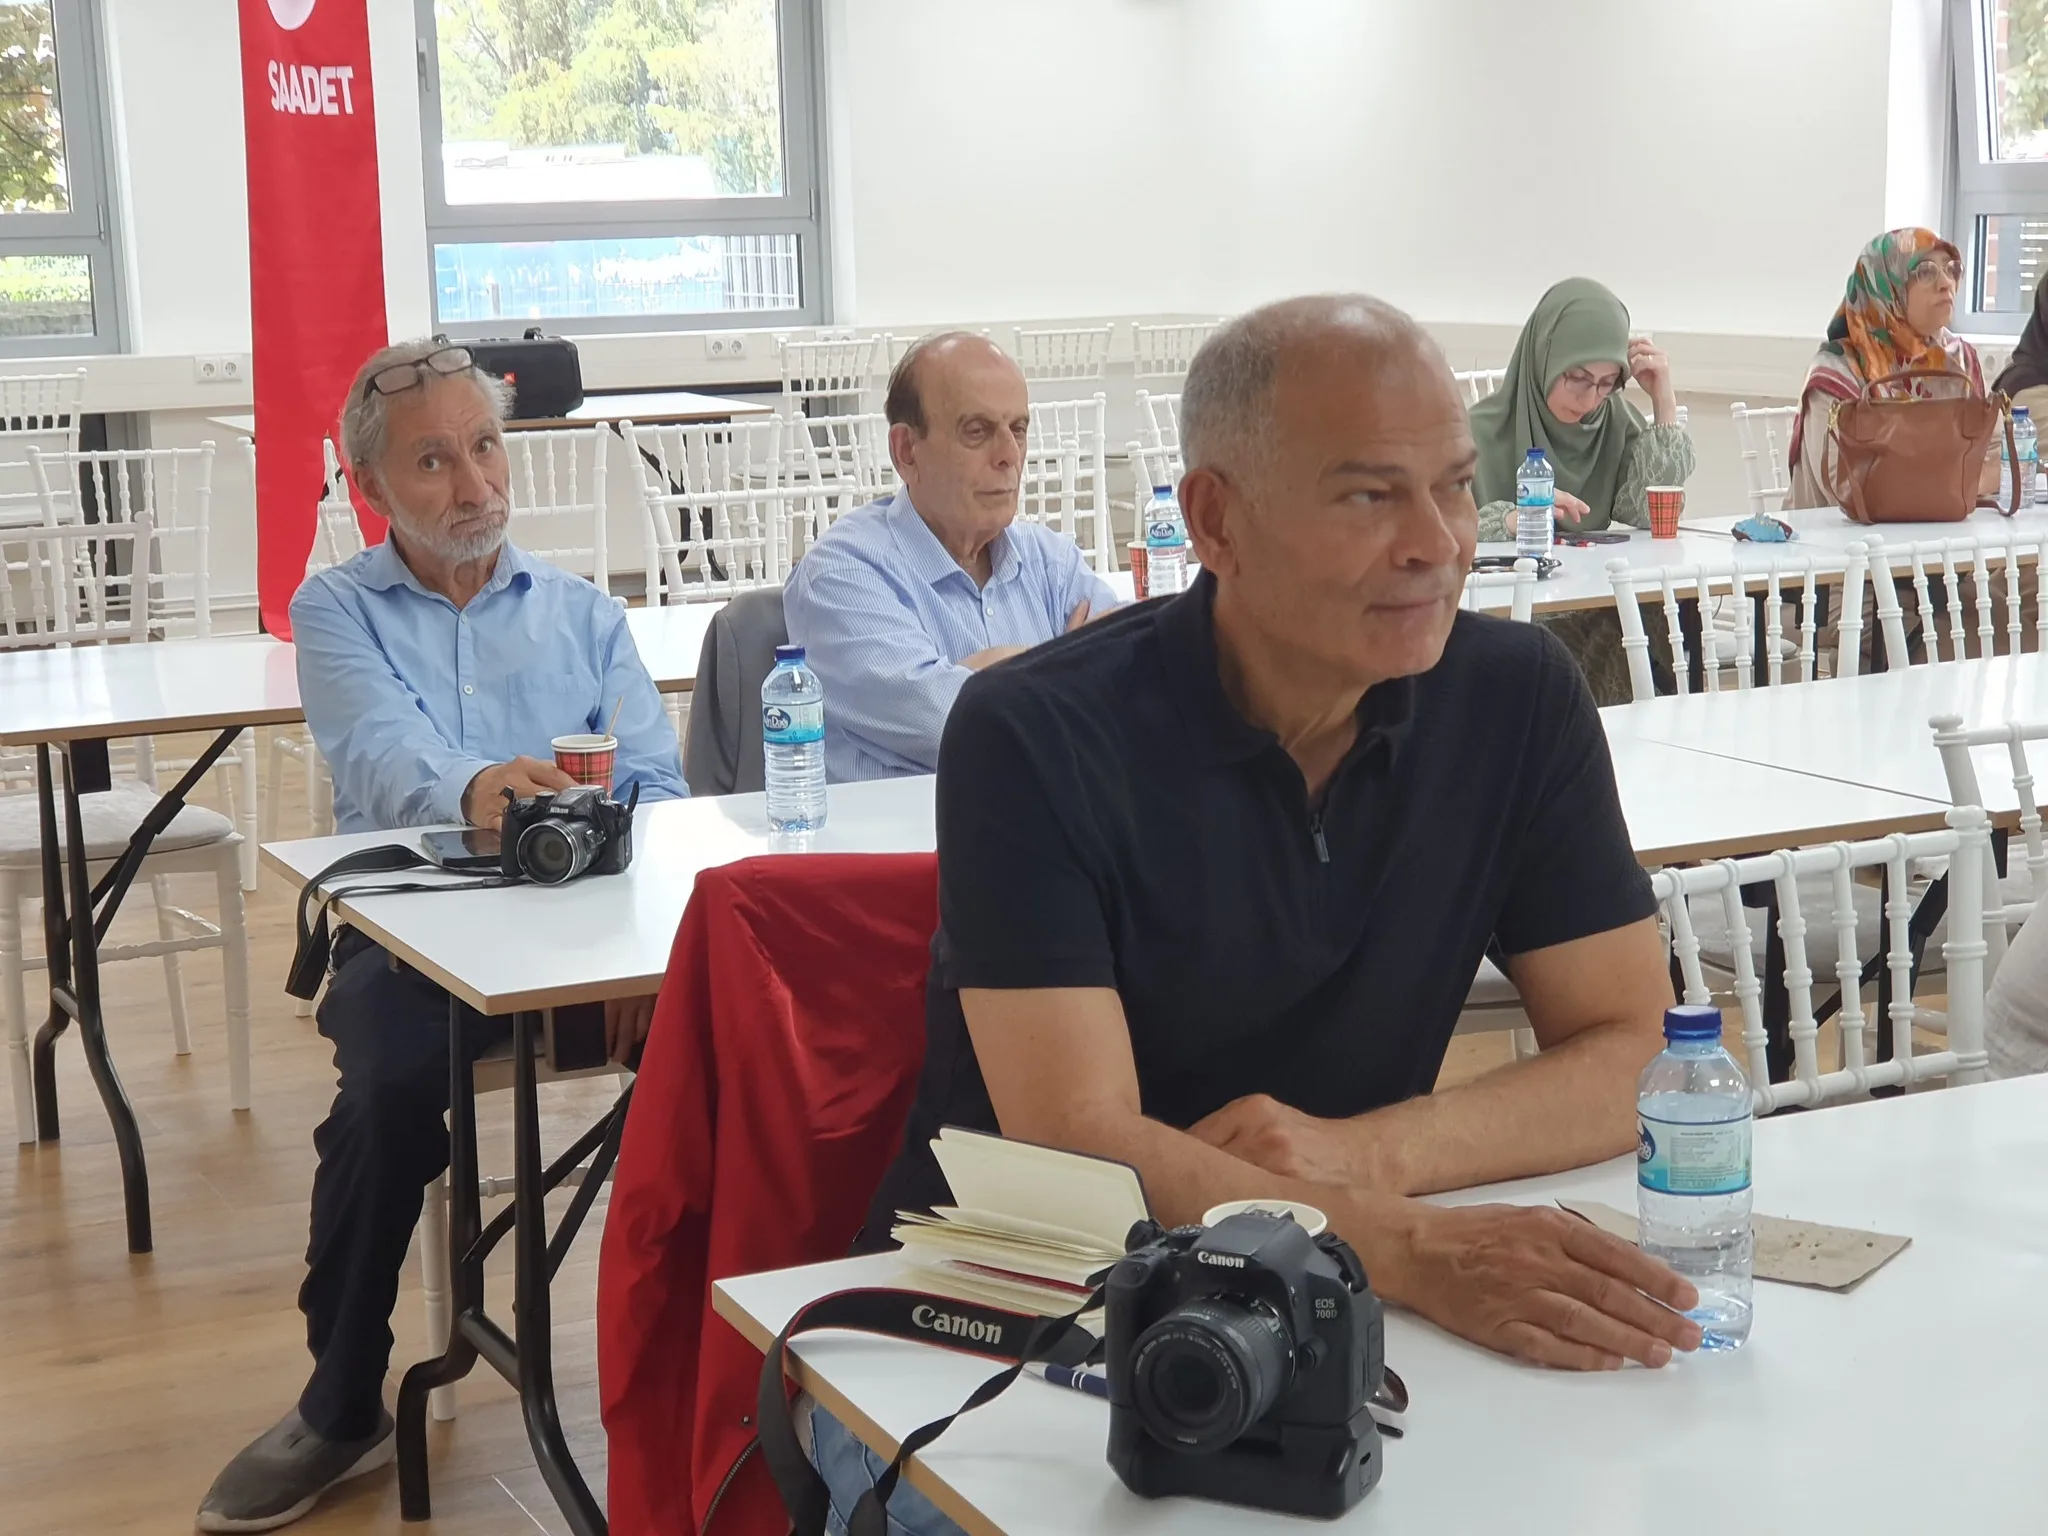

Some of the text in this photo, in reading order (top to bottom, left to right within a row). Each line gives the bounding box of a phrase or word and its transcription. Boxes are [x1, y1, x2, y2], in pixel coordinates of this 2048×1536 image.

[267, 59, 355, 116] SAADET
[1197, 1250, 1245, 1269] Canon
[1315, 1298, 1335, 1309] EOS
[911, 1304, 1003, 1345] Canon
